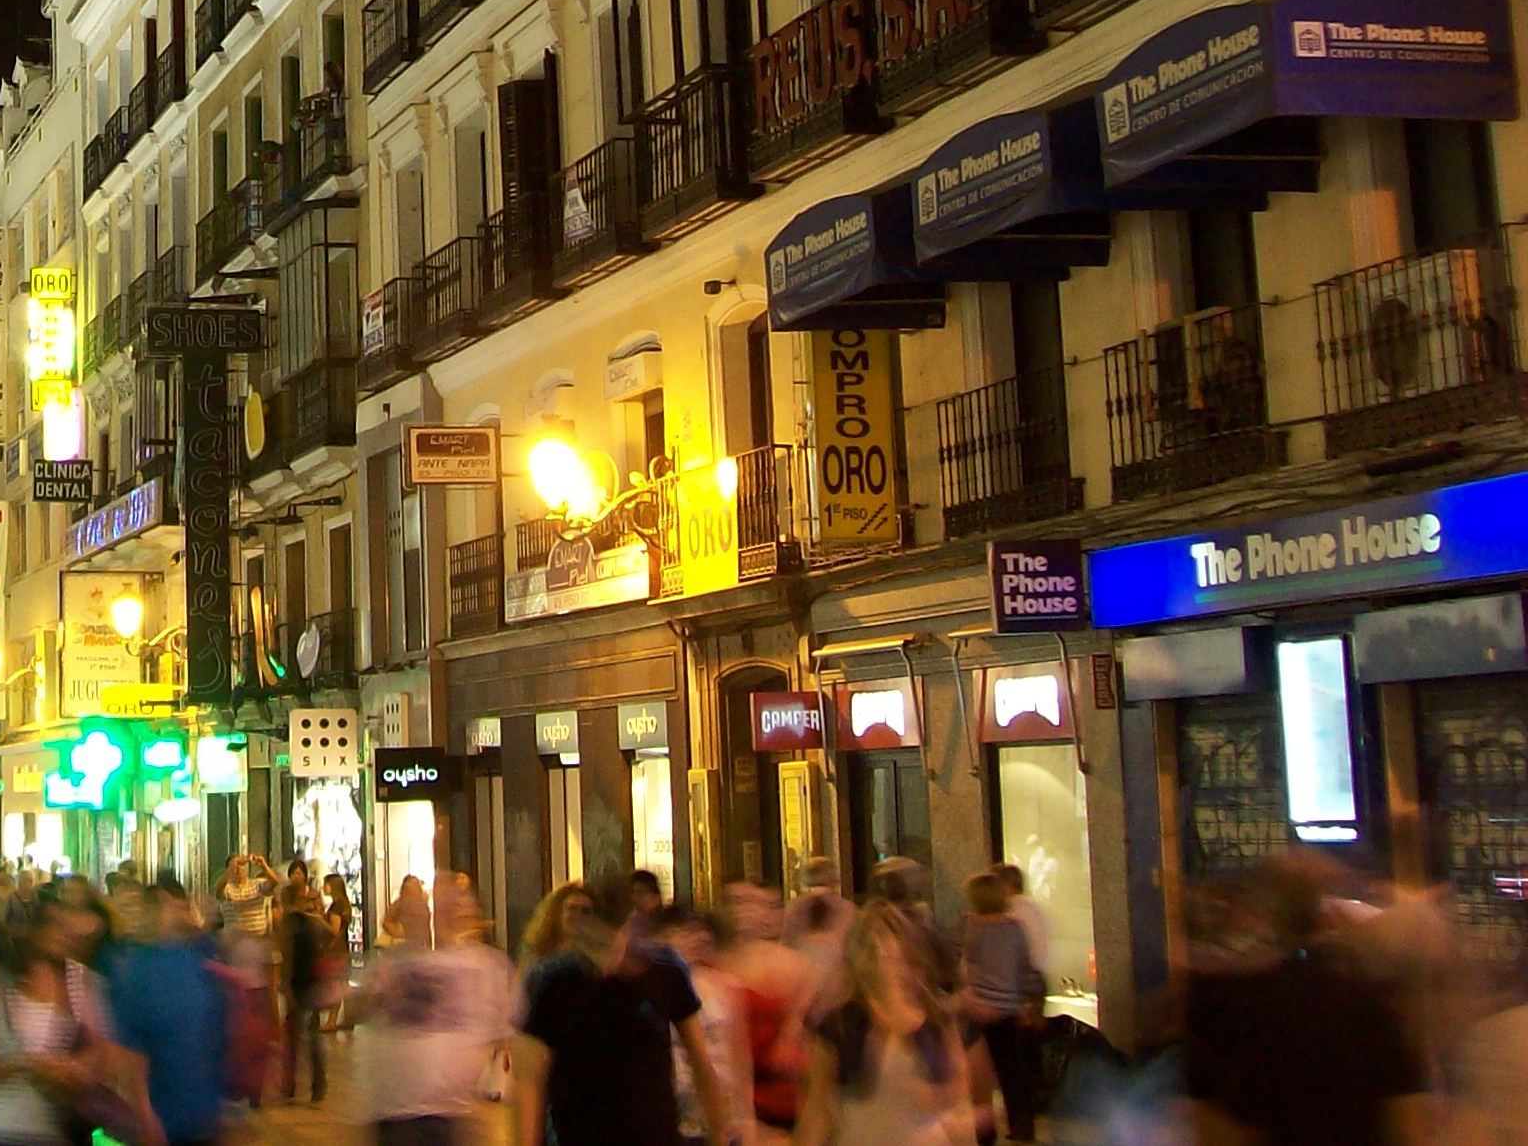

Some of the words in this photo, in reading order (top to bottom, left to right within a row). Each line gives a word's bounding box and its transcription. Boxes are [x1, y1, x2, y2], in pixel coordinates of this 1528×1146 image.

[1328, 22, 1363, 40] The
[1366, 23, 1425, 41] Phone
[1427, 25, 1486, 44] House
[1128, 75, 1157, 103] The
[1158, 50, 1206, 90] Phone
[1207, 25, 1259, 66] House
[937, 167, 959, 192] The
[961, 149, 999, 182] Phone
[1000, 131, 1041, 164] House
[805, 228, 834, 257] Phone
[835, 211, 867, 241] House
[34, 274, 69, 294] ORO
[153, 313, 258, 348] SHOES
[831, 329, 870, 438] OMPRO
[823, 445, 887, 495] ORO
[36, 482, 89, 499] DENTAL
[843, 507, 868, 521] PISO
[688, 506, 732, 559] ORO
[1001, 553, 1048, 572] The
[1191, 542, 1243, 588] The
[1247, 531, 1337, 582] Phone
[1342, 513, 1441, 567] House
[1002, 573, 1076, 594] Phone
[1004, 595, 1077, 616] House
[543, 717, 570, 748] oysho
[626, 707, 657, 743] oysho
[761, 709, 821, 735] CAMPER
[302, 755, 347, 767] SIX
[383, 764, 438, 787] oysho
